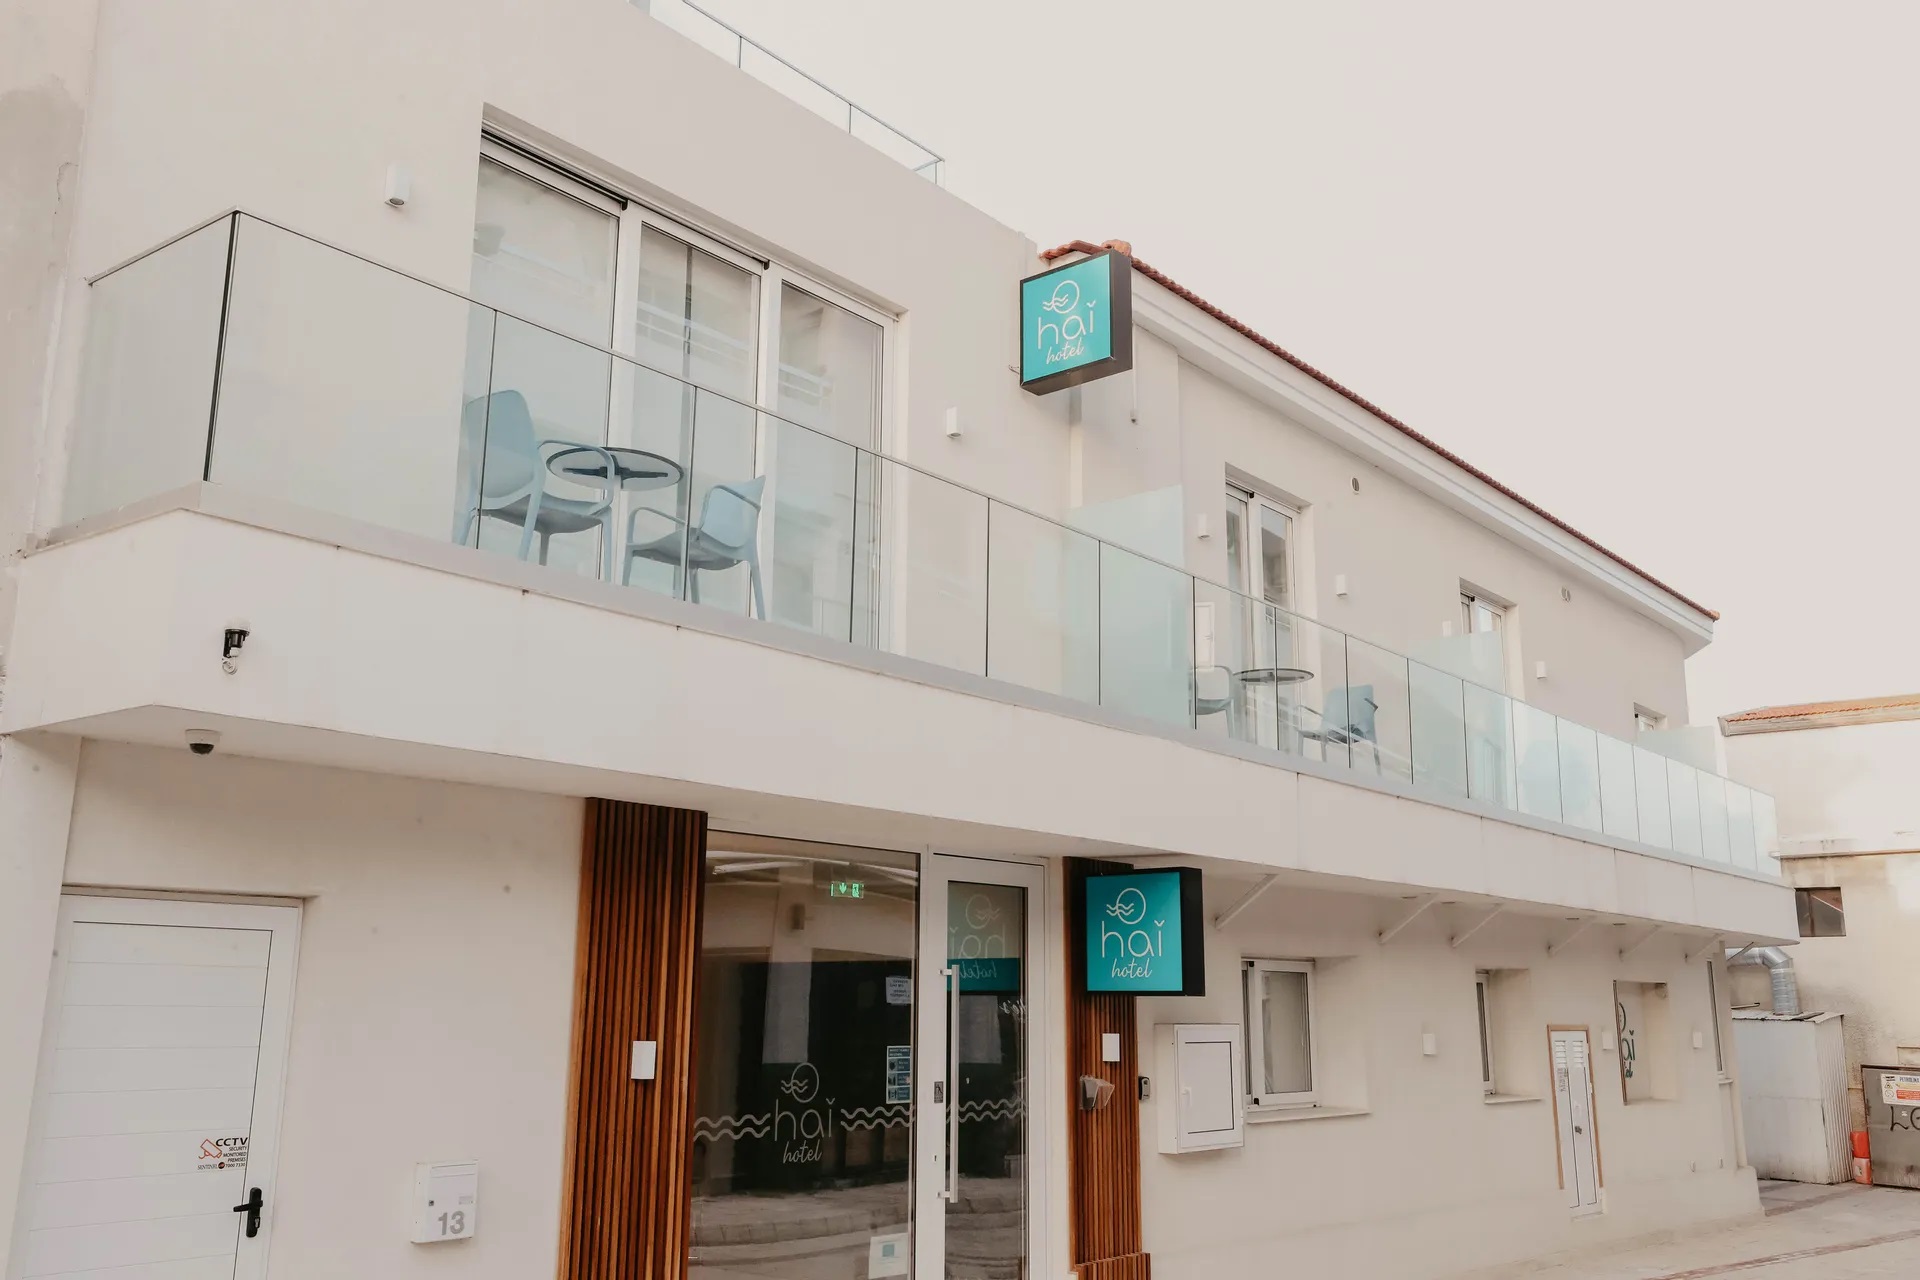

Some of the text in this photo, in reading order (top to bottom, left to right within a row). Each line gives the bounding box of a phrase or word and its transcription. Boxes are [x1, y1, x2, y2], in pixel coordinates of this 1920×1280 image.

[1045, 337, 1084, 365] hotel
[1111, 957, 1153, 979] hotel
[215, 1137, 248, 1147] CCTV
[782, 1138, 823, 1164] hotel
[438, 1210, 465, 1236] 13
